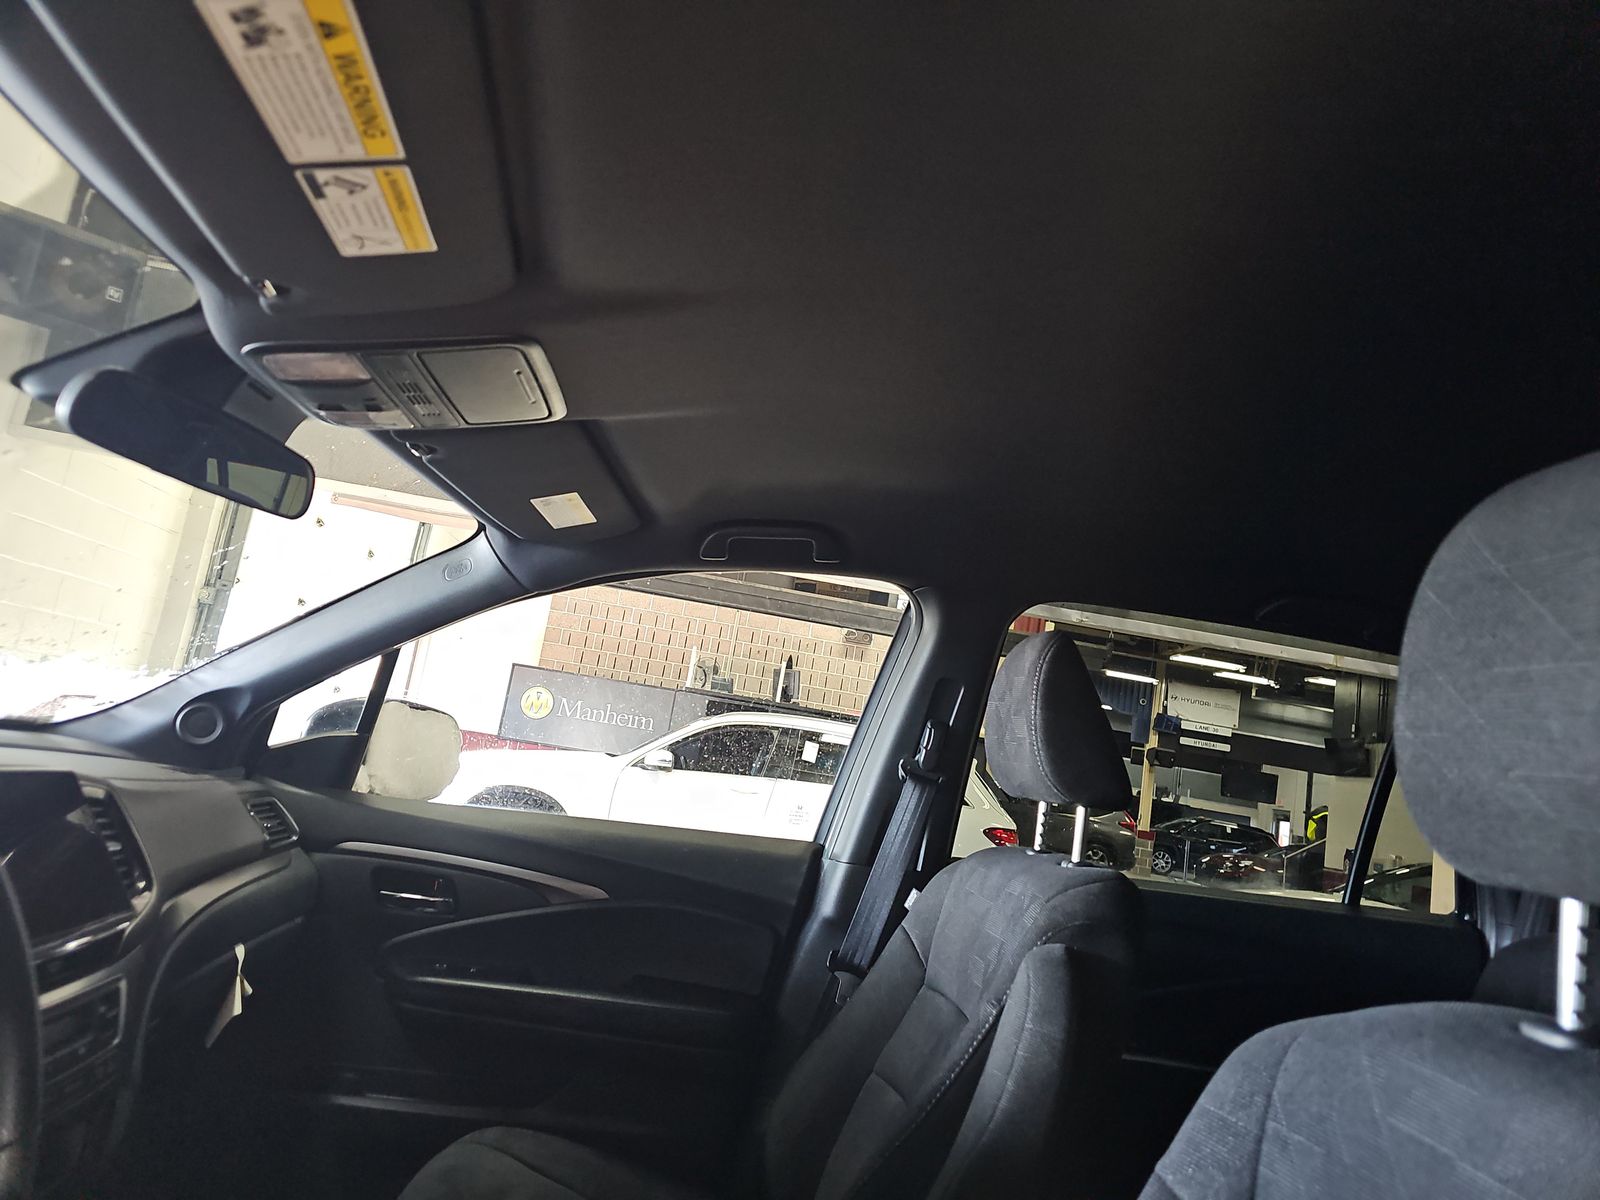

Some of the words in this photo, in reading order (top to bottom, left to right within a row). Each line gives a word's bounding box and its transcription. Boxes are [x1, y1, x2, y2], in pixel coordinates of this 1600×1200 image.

[333, 53, 387, 139] WARNING
[1180, 697, 1211, 707] HYUNDAI
[556, 697, 655, 731] Manheim
[1193, 740, 1218, 748] HYUNDAI
